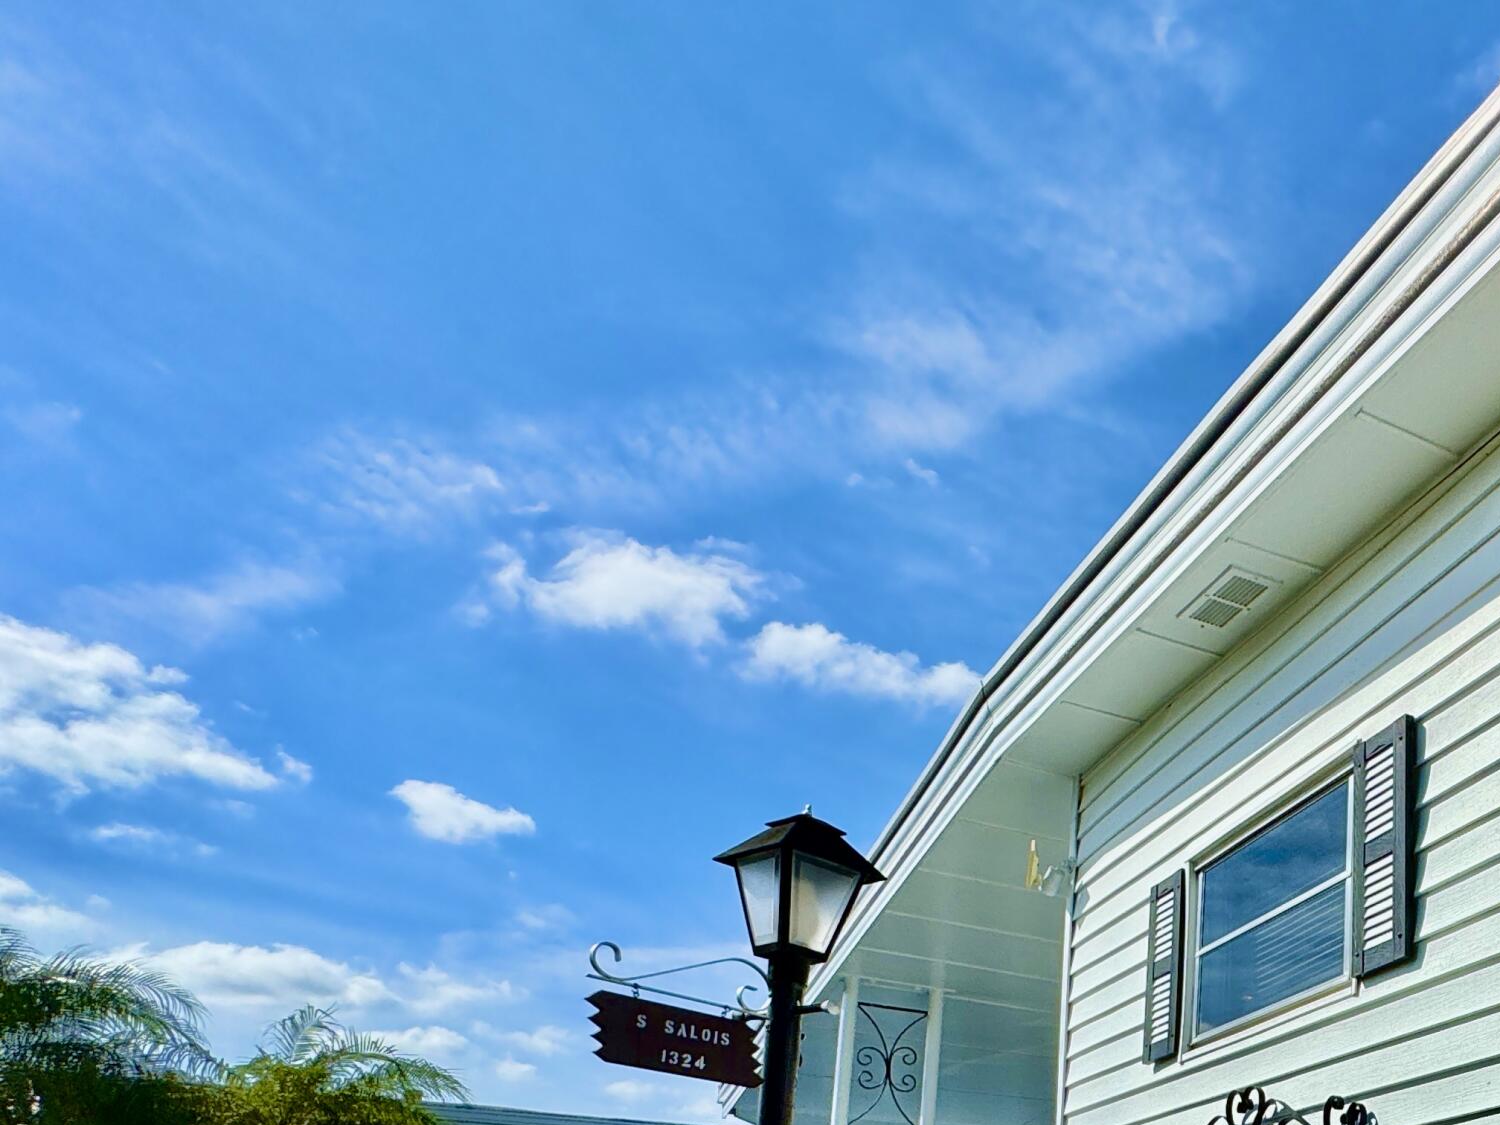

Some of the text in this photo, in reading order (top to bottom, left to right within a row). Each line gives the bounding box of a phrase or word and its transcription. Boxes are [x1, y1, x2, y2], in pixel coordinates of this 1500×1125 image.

[636, 1014, 731, 1046] S SALOIS
[661, 1049, 706, 1070] 1324
